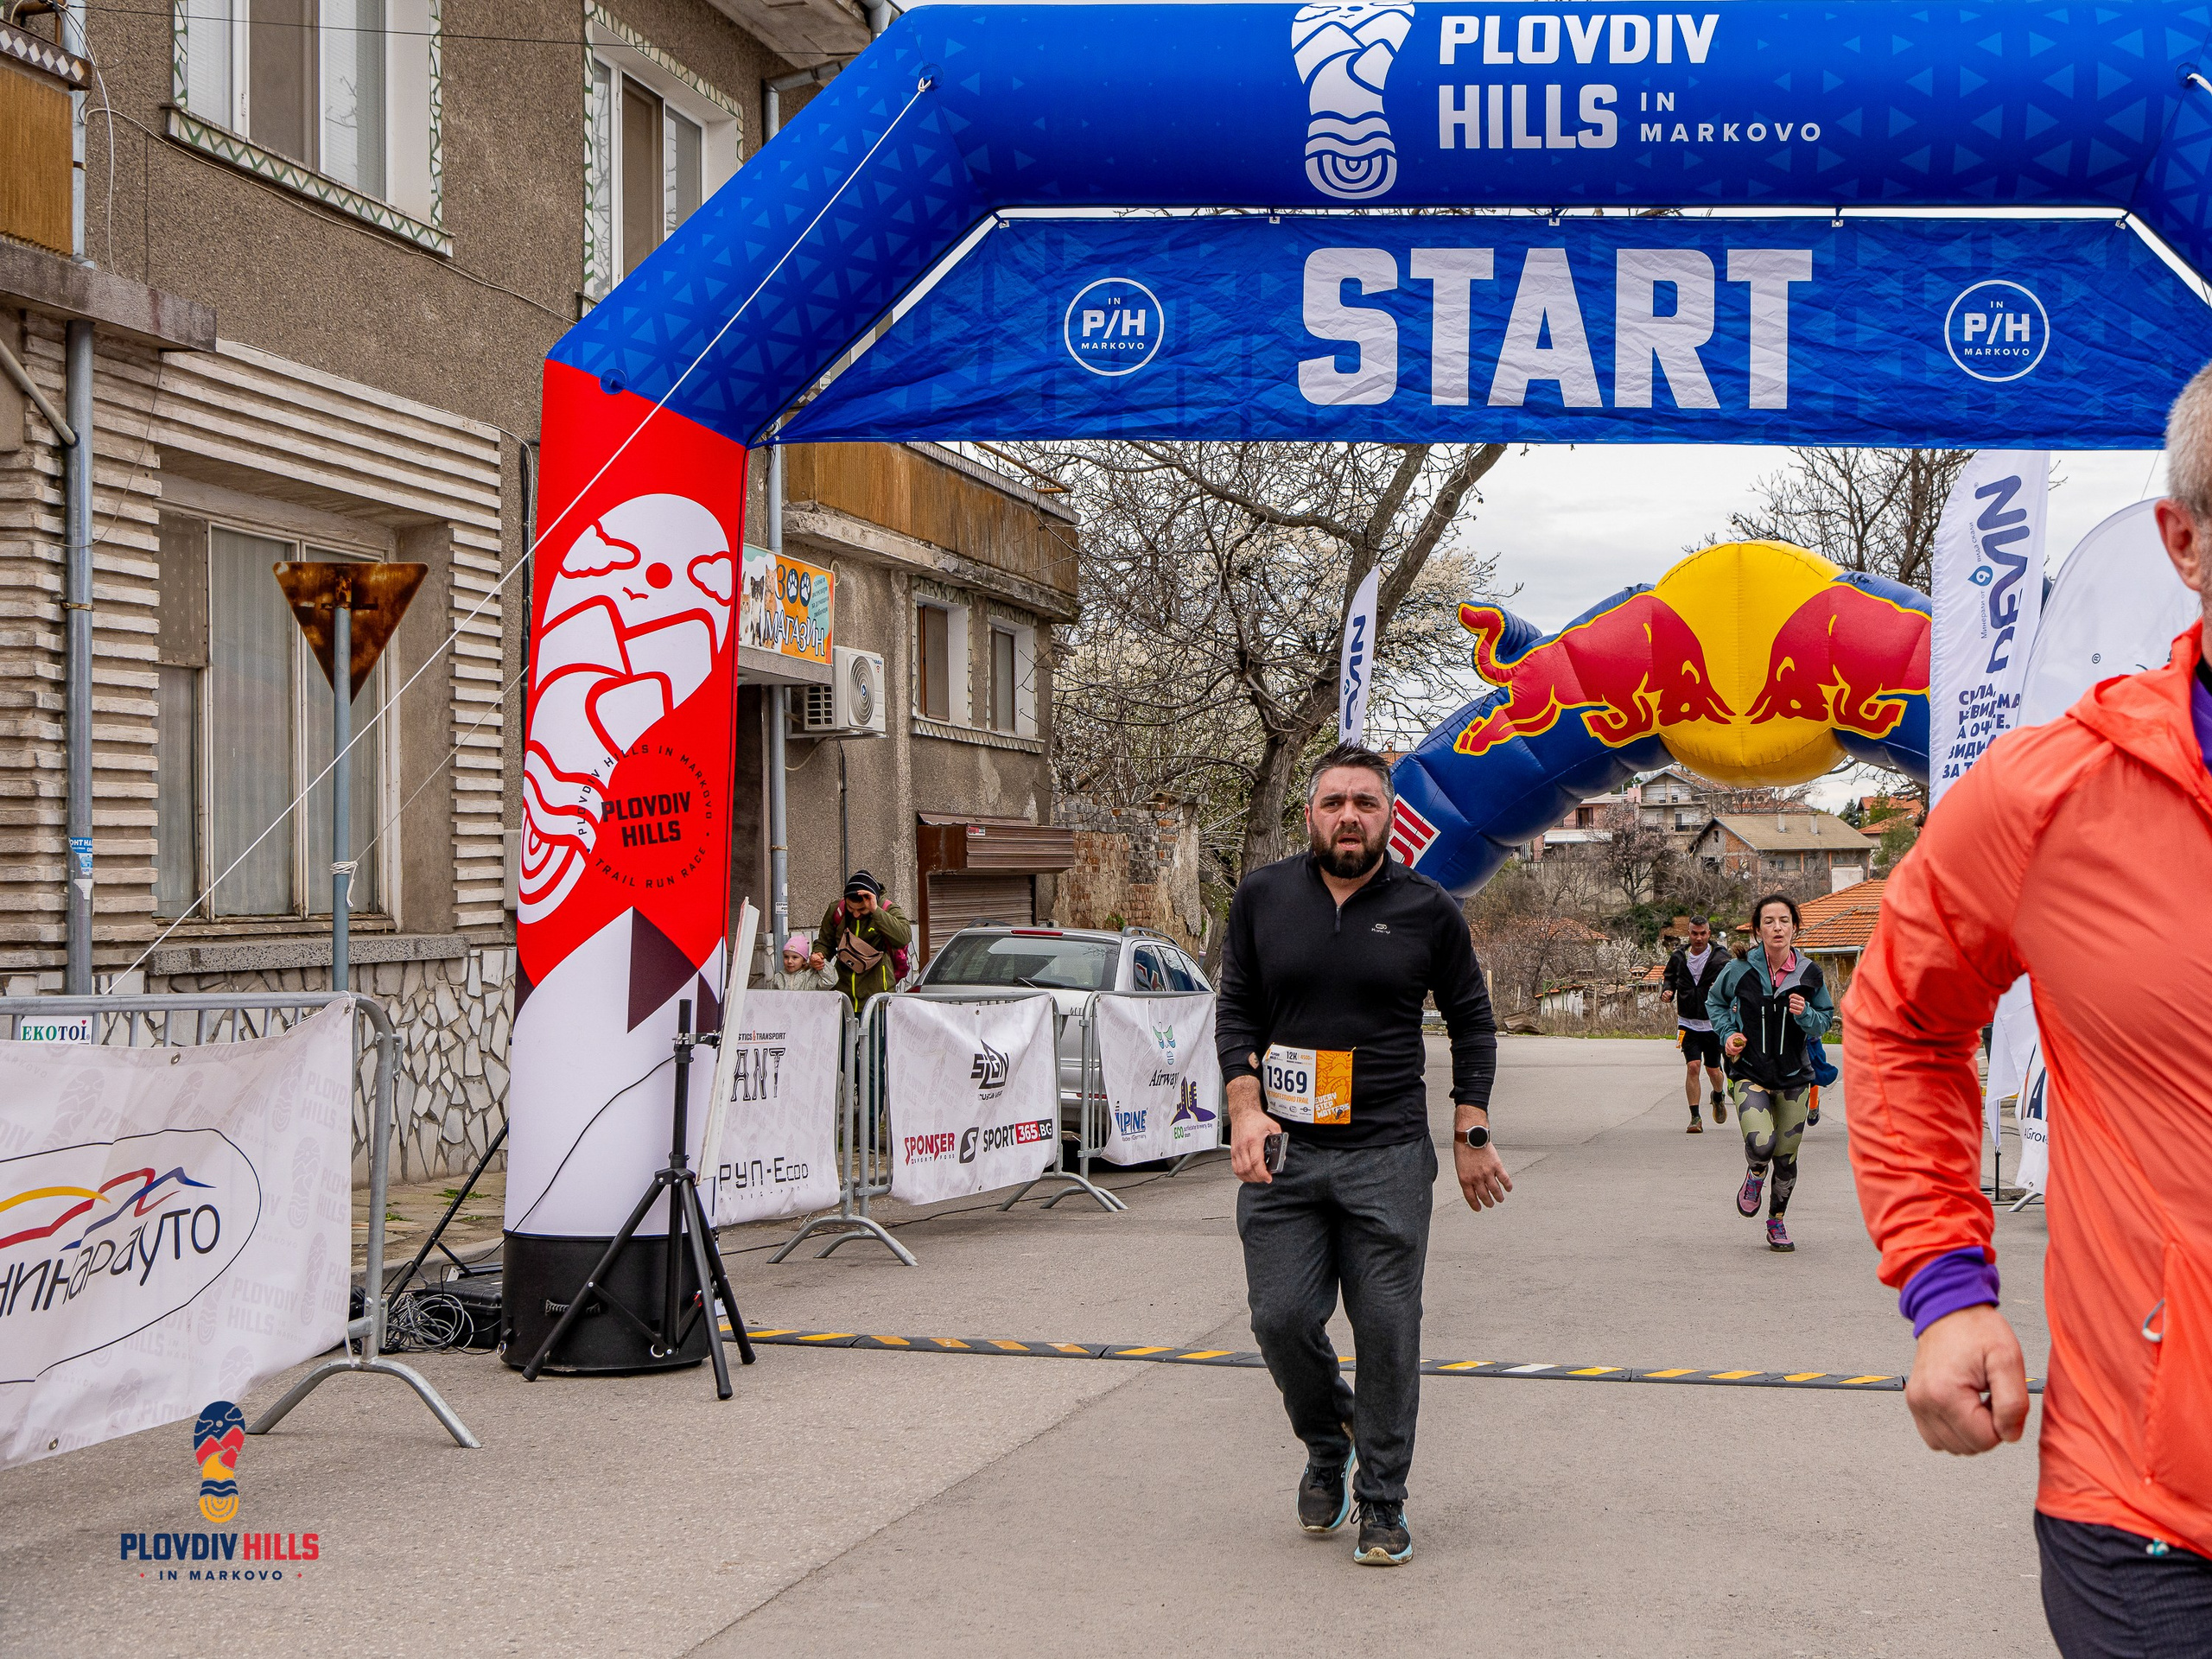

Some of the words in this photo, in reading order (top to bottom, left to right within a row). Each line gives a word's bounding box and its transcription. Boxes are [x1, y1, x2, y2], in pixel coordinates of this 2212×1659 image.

[1439, 14, 1720, 65] PLOVDIV
[1439, 84, 1618, 149] HILLS
[1640, 92, 1675, 111] IN
[1640, 123, 1821, 143] MARKOVO
[1082, 308, 1147, 340] P/H
[1298, 247, 1813, 410] START
[1964, 313, 2030, 345] P/H
[764, 609, 825, 657] МАГАЗИН
[576, 768, 601, 836] PLOVDIV
[603, 744, 649, 767] HILLS
[658, 745, 673, 757] IN
[680, 753, 713, 819] MARKOVO
[601, 791, 690, 823] PLOVDIV
[621, 820, 681, 848] HILLS
[594, 858, 636, 887] TRAIL
[645, 875, 675, 888] RUN
[681, 847, 706, 878] RACE
[1149, 1070, 1180, 1090] Airway
[1267, 1065, 1308, 1094] 1369
[1314, 1100, 1334, 1111] STEP
[904, 1132, 956, 1166] SPONSER
[1173, 1126, 1185, 1140] ECO
